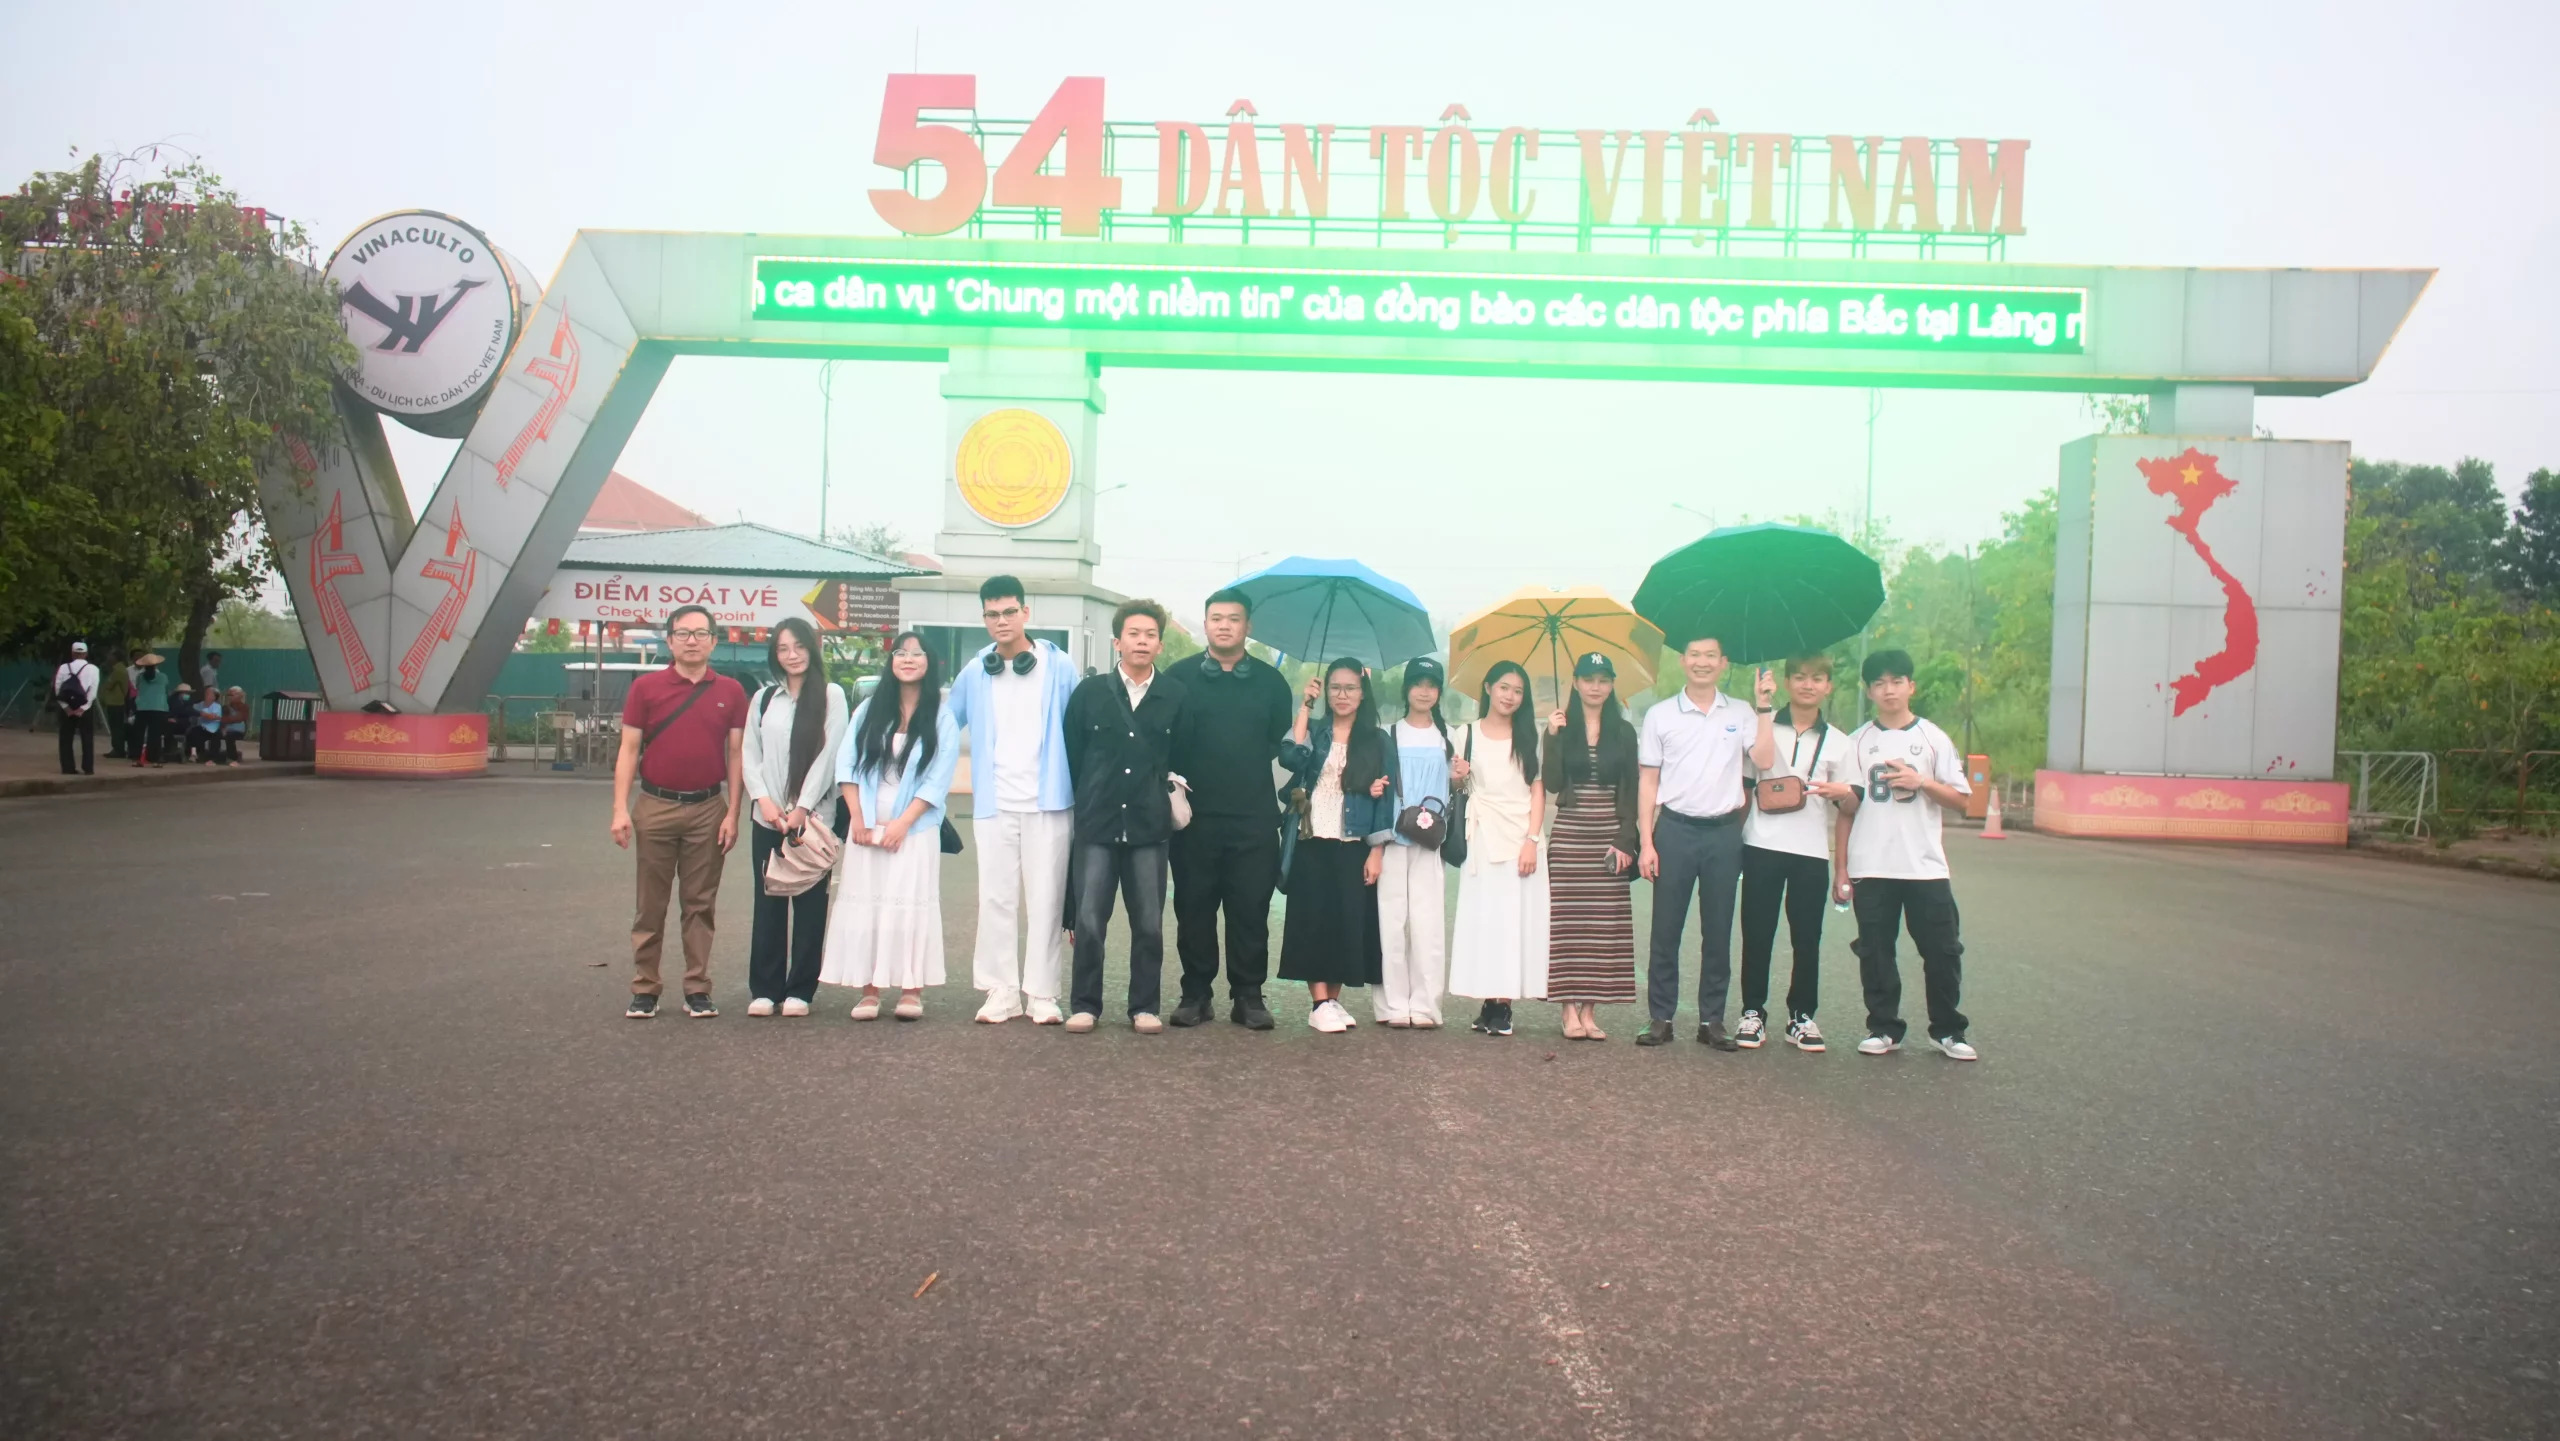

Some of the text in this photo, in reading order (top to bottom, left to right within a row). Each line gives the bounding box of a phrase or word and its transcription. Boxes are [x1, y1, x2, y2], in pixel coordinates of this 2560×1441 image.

[867, 73, 2031, 247] 54 DÂN TỘC VIỆT NAM
[352, 227, 475, 265] VINACULTO
[775, 281, 814, 307] ca
[824, 276, 887, 309] dân
[1075, 282, 1140, 321] một
[1148, 277, 1231, 317] niềm
[1303, 286, 1366, 322] của
[1374, 282, 1461, 331] đồng
[1544, 292, 1608, 328] các
[1615, 294, 1681, 329] dân
[1689, 296, 1745, 337] tộc
[1752, 297, 1829, 339] phía
[1839, 294, 1909, 335] Bắc
[1916, 302, 1959, 342] tại
[1969, 302, 2057, 346] Làng
[370, 385, 388, 400] DU
[388, 392, 413, 407] LỊCH
[416, 394, 440, 408] CÁC
[440, 385, 464, 403] DÂN
[479, 346, 497, 369] VIỆT
[491, 319, 504, 345] NAM
[574, 574, 778, 608] ĐIỂM SOÁT VÉ
[597, 605, 653, 619] Check
[713, 610, 756, 623] point
